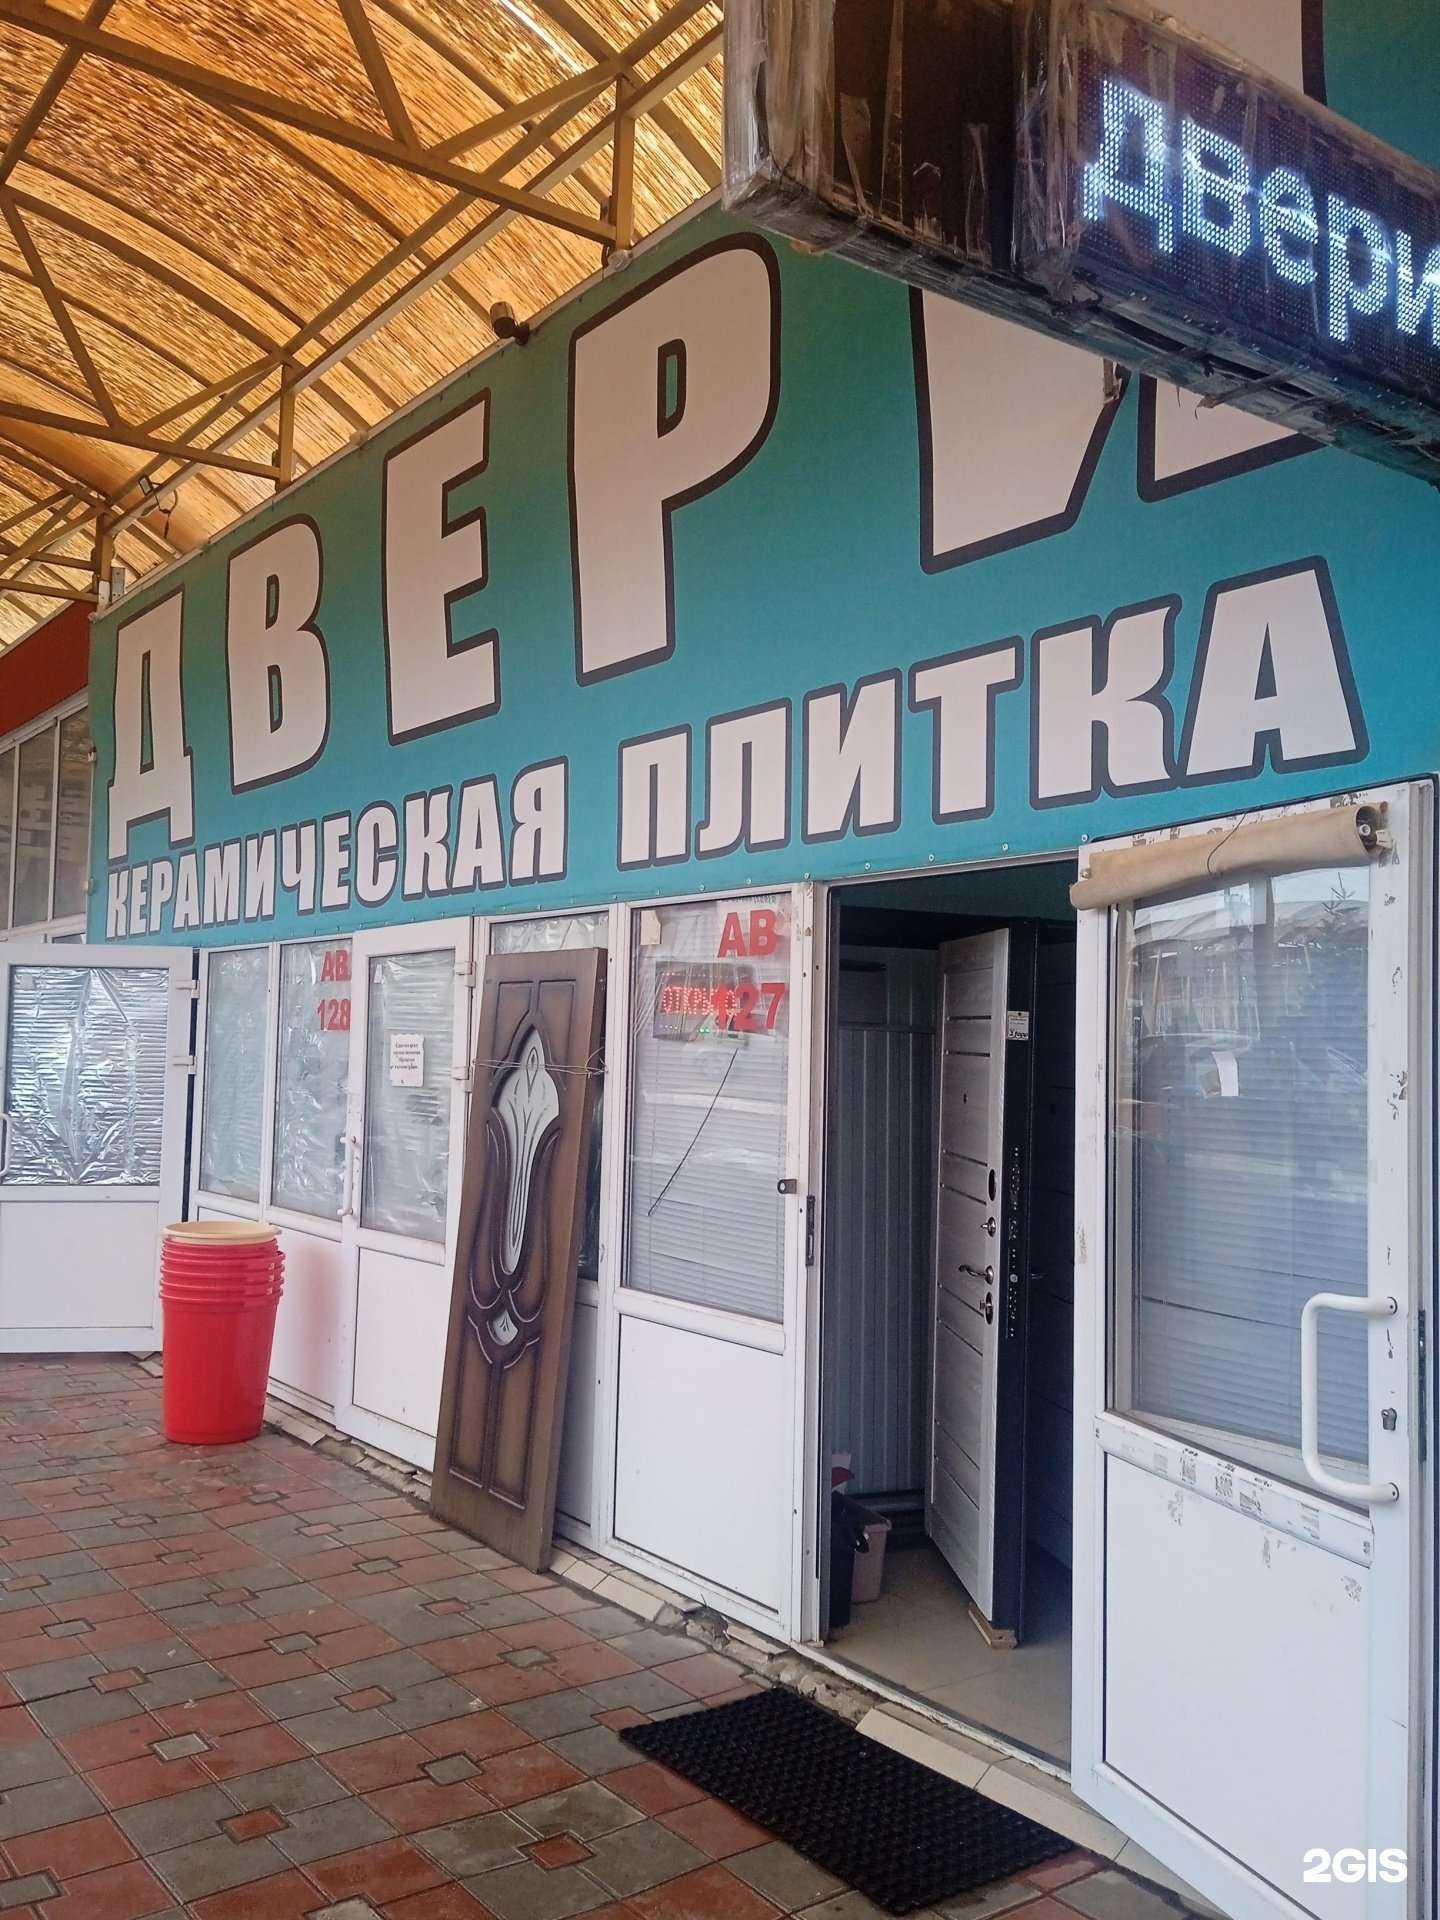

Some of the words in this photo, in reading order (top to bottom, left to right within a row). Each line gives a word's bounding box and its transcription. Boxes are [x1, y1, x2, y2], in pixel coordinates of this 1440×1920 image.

[1083, 79, 1440, 346] Двери
[104, 755, 569, 942] КЕРАМИЧЕСКАЯ
[617, 555, 1369, 871] ПЛИТКА
[317, 998, 352, 1032] 128
[712, 981, 786, 1033] 127
